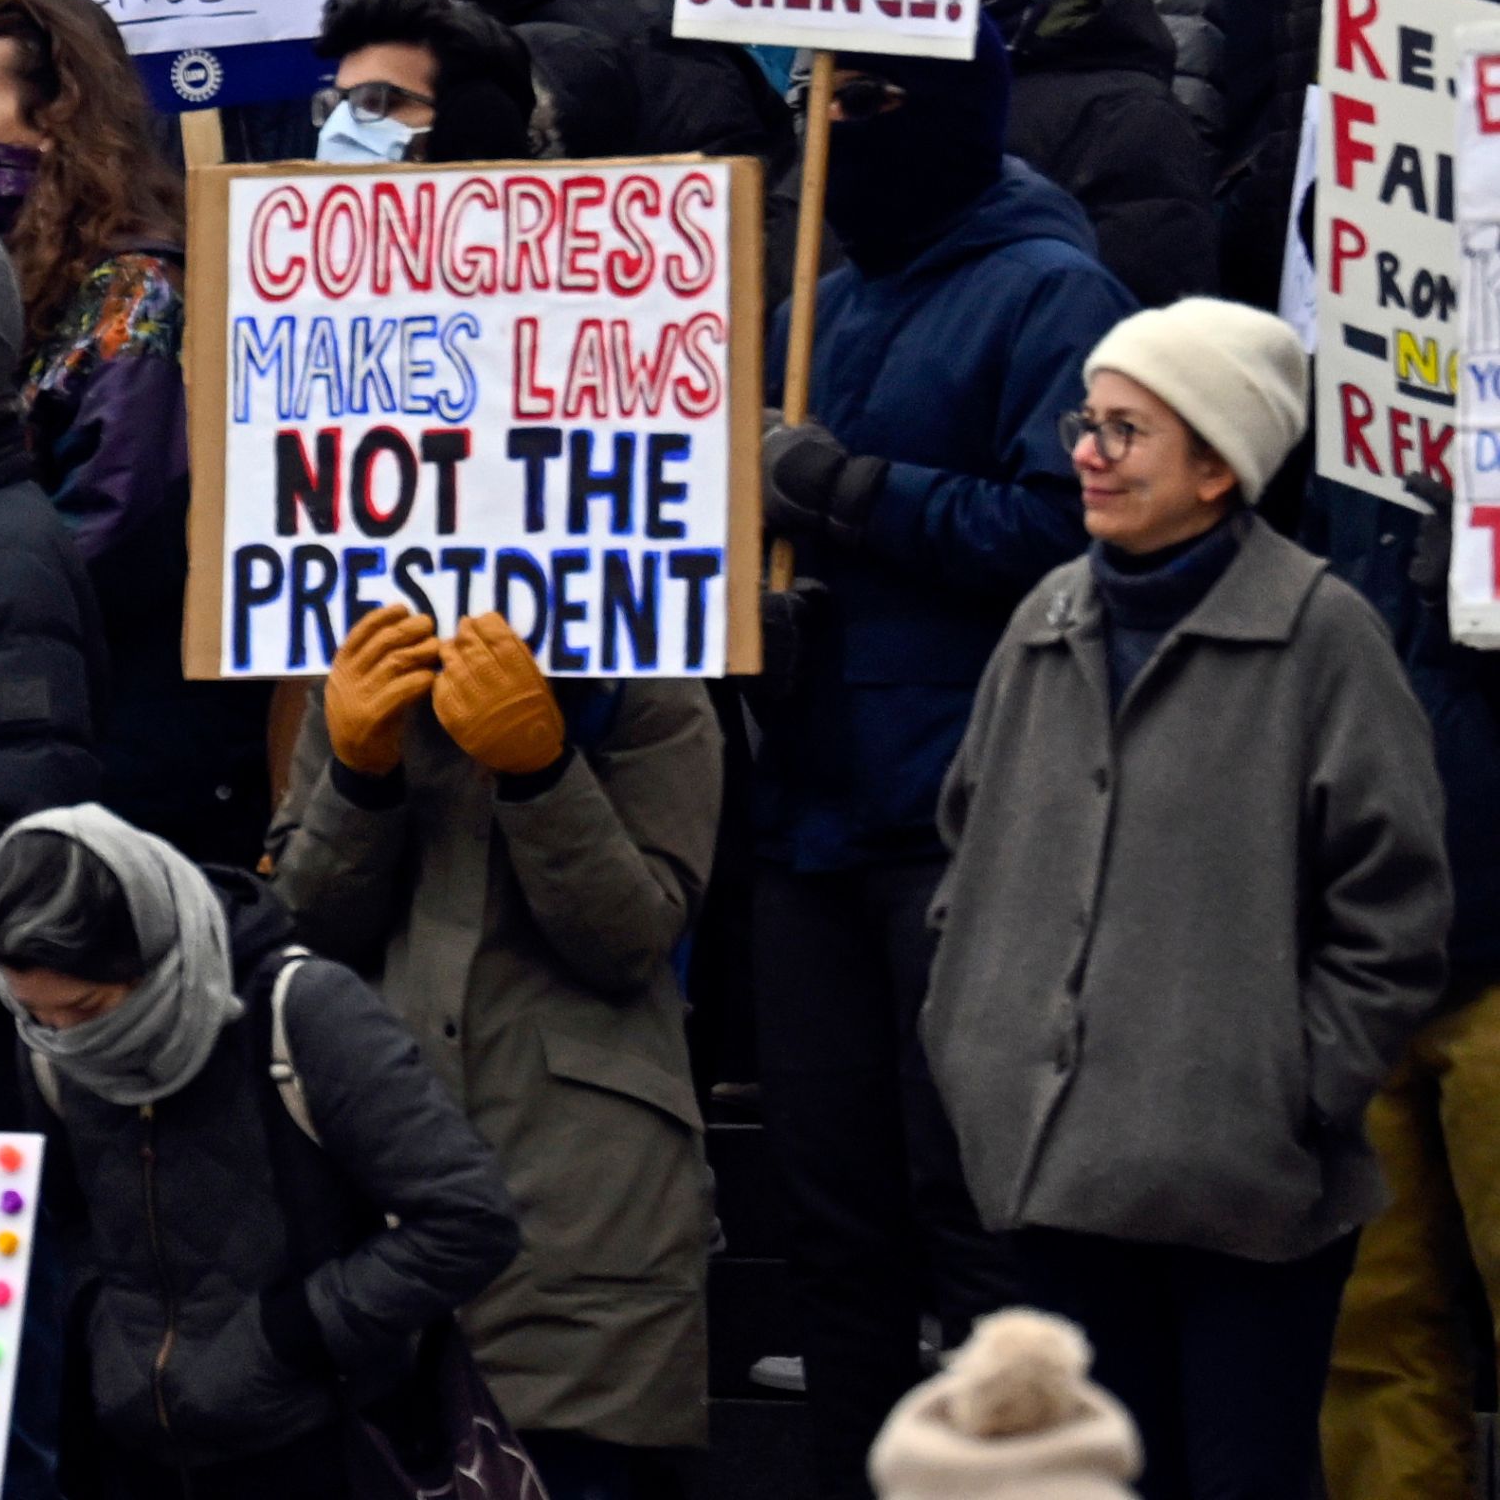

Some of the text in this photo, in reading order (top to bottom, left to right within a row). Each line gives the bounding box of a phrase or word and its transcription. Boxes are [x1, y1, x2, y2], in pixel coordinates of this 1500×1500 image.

[249, 173, 716, 300] CONGRESS
[234, 312, 728, 423] MAKES LAWS
[275, 425, 693, 539] NOT THE
[1339, 381, 1456, 491] RFK
